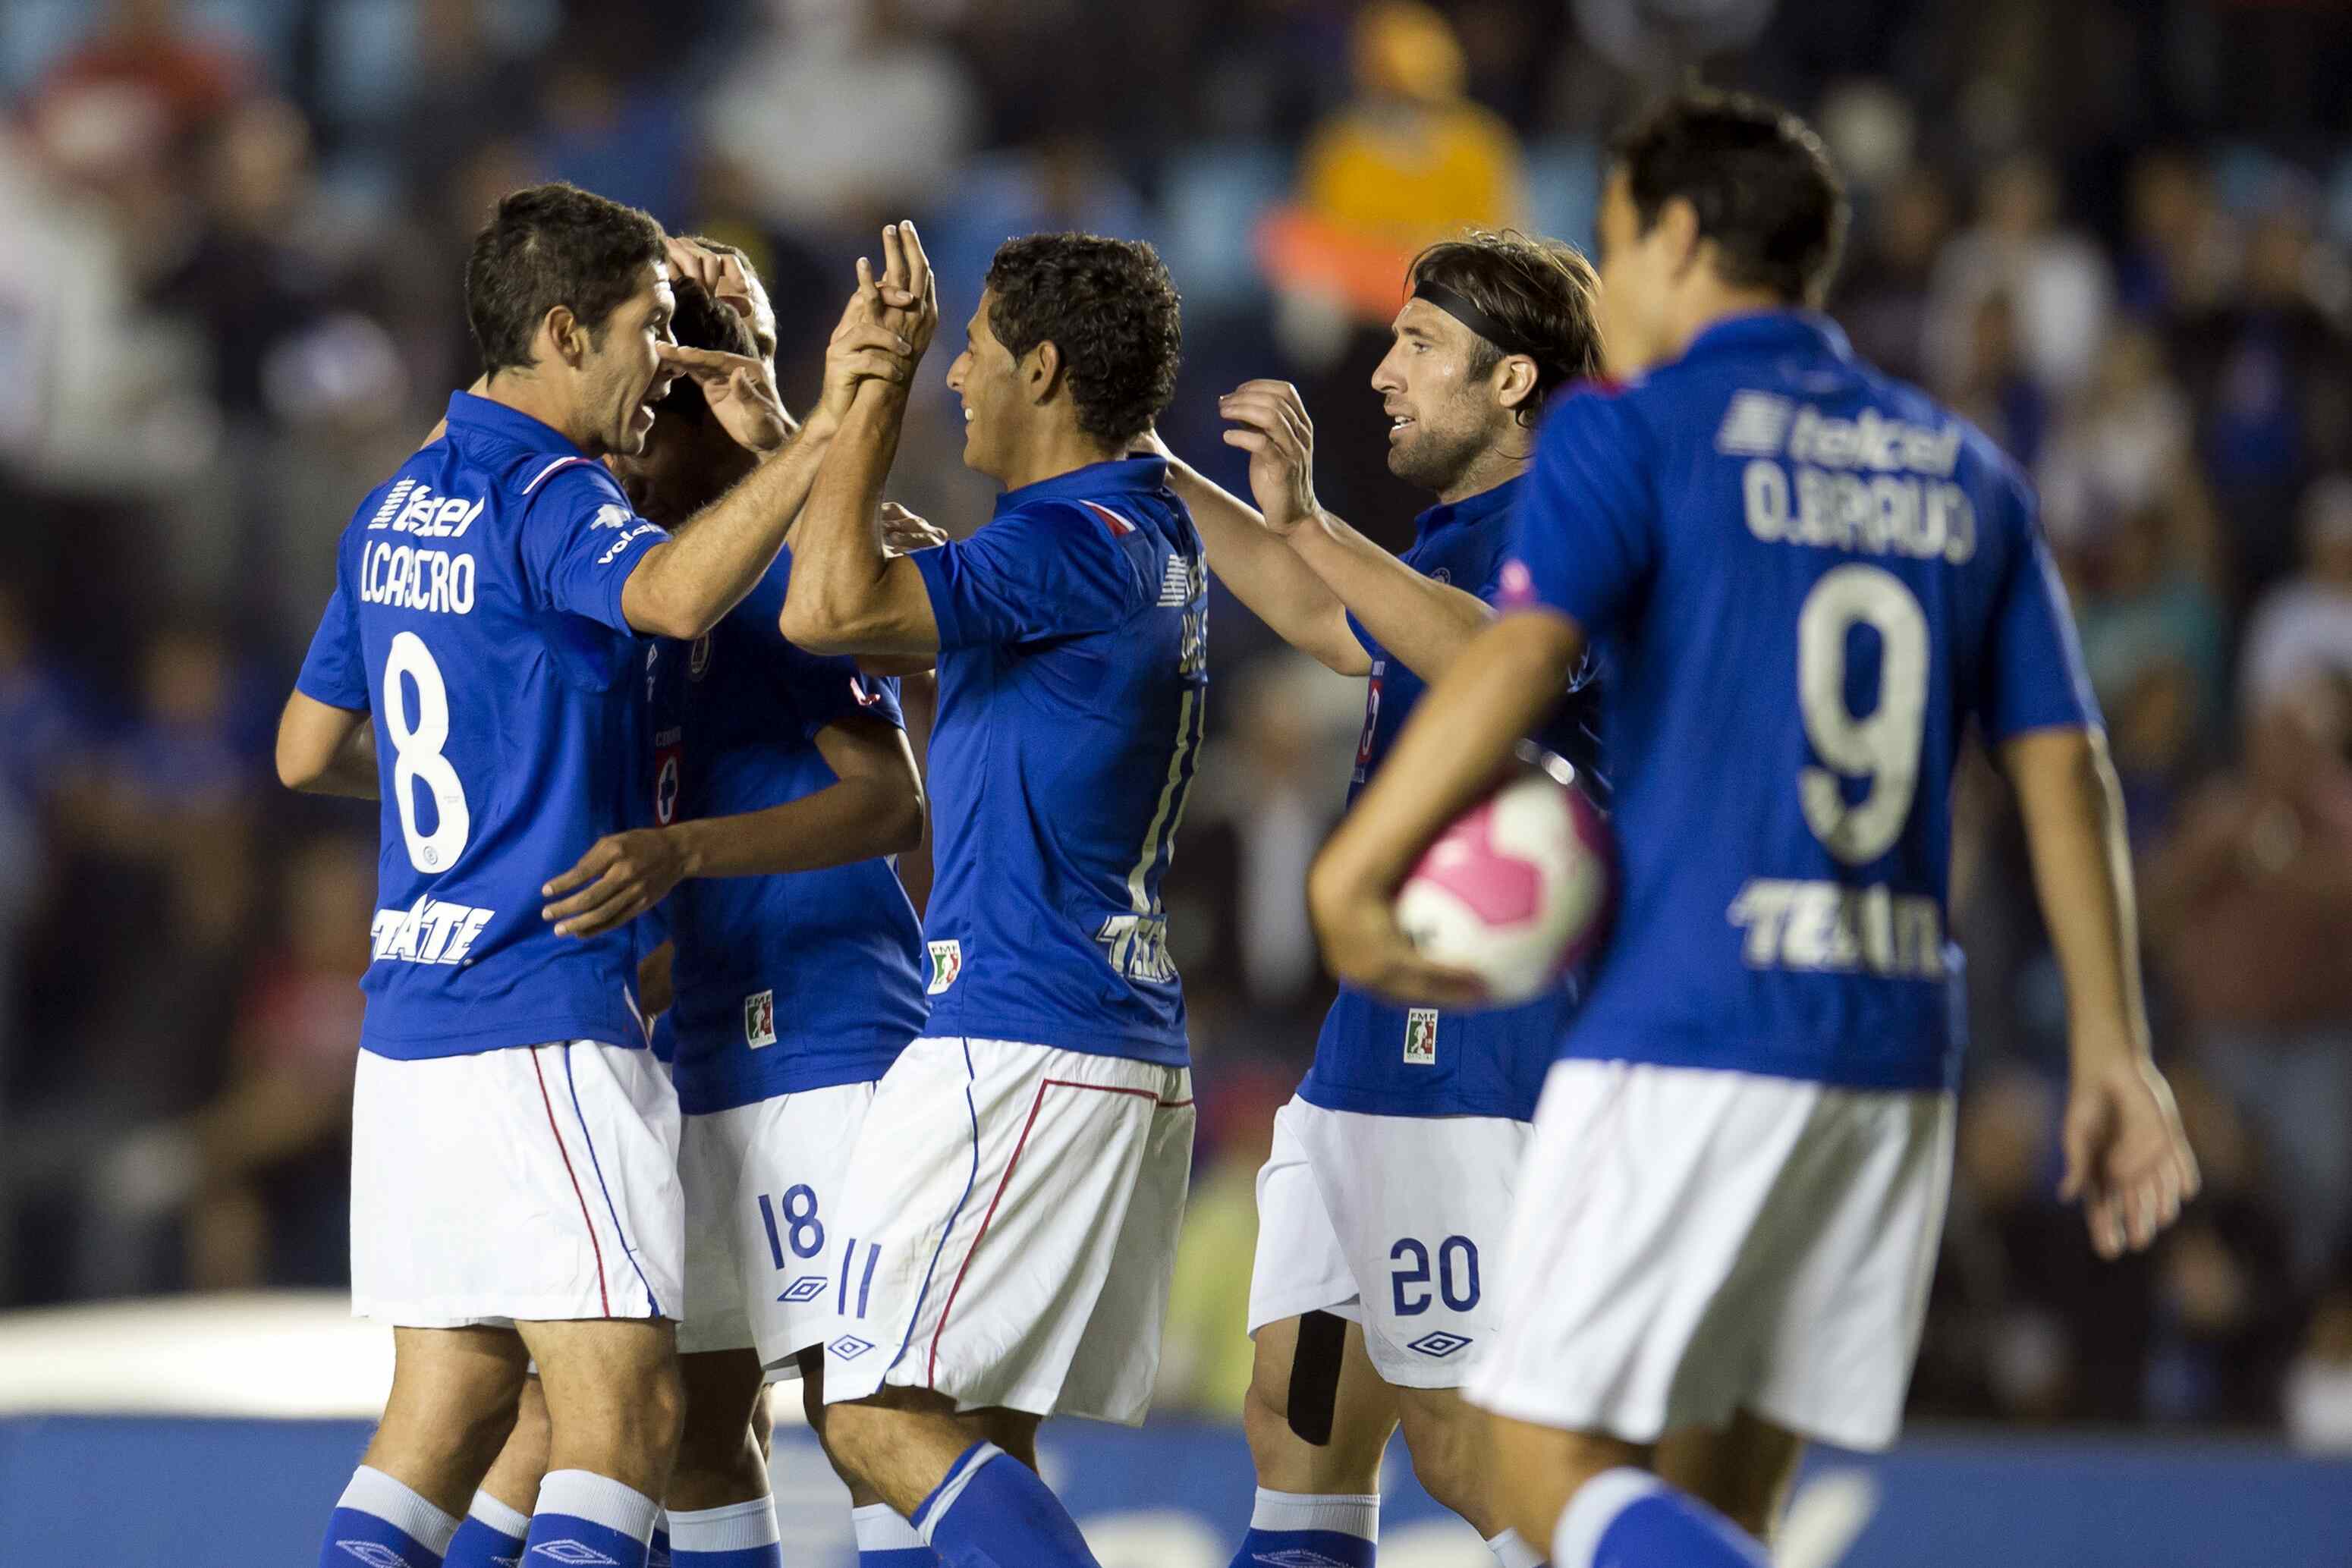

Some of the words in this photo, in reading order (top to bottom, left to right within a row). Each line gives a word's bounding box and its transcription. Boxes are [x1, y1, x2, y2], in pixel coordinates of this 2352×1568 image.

[384, 631, 470, 874] 8
[1797, 561, 1932, 866] 9
[759, 1183, 825, 1270] 18
[838, 1238, 882, 1318] 11
[1390, 1235, 1480, 1316] 20
